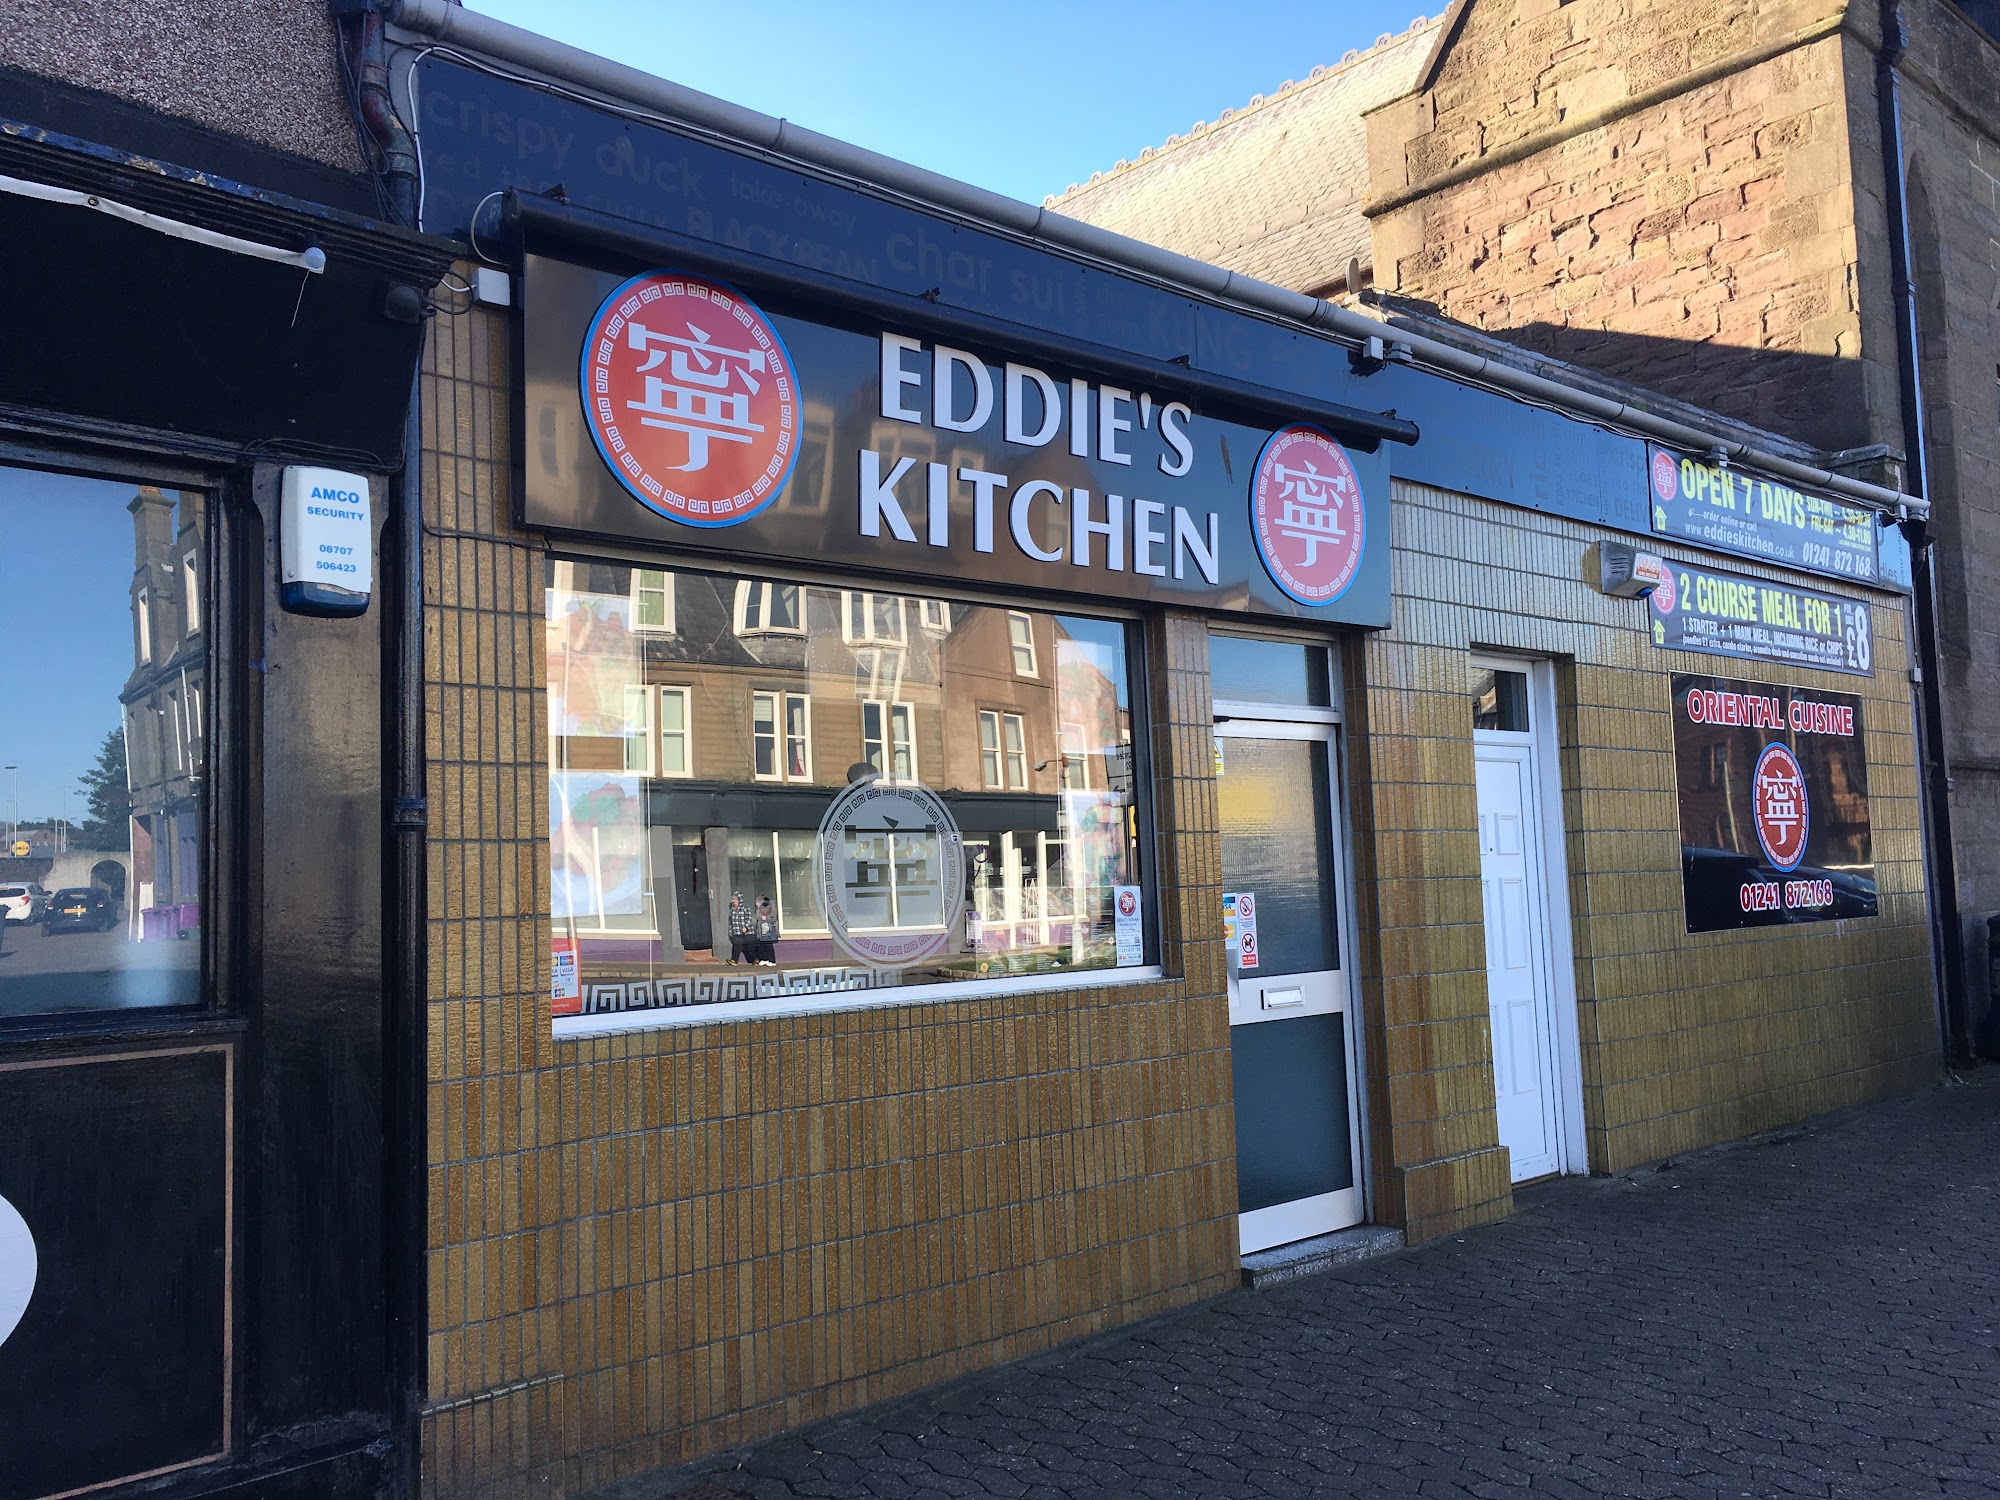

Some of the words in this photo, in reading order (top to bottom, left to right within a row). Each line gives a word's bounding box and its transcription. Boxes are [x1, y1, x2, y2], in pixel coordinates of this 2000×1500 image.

[880, 331, 1194, 477] EDDIE'S
[311, 486, 360, 505] AMCO
[1614, 496, 1648, 524] DELIV
[1681, 458, 1735, 510] OPEN
[1741, 476, 1753, 514] 7
[1760, 482, 1805, 529] DAYS
[307, 506, 364, 521] SECURITY
[858, 449, 1219, 585] KITCHEN
[1703, 510, 1720, 523] order
[1720, 515, 1739, 528] online
[1739, 520, 1747, 529] or
[1746, 522, 1758, 533] call
[319, 544, 353, 555] 08707
[1685, 522, 1795, 559] www.eddieskitchen.co.uk
[316, 561, 356, 573] 506423
[1802, 541, 1830, 567] 01241
[1834, 549, 1853, 573] 872
[1855, 554, 1871, 577] 168
[1680, 572, 1692, 611] 2
[1696, 575, 1758, 622] COURSE
[1761, 588, 1802, 631] MEAL
[1804, 597, 1831, 635] FOR
[1834, 603, 1843, 638] 1
[1682, 616, 1686, 631] 1
[1688, 617, 1718, 636] STARTER
[1728, 623, 1733, 638] 1
[1734, 624, 1752, 641] MAIN
[1773, 630, 1805, 650] INCLUDING
[1805, 636, 1819, 652] RICE
[1826, 640, 1844, 657] CHIPS
[1847, 605, 1870, 671] £8
[1687, 688, 1785, 730] ORIENTAL
[1788, 700, 1854, 737] CUISINE
[1740, 881, 1781, 912] 01241
[1784, 879, 1833, 910] 872168
